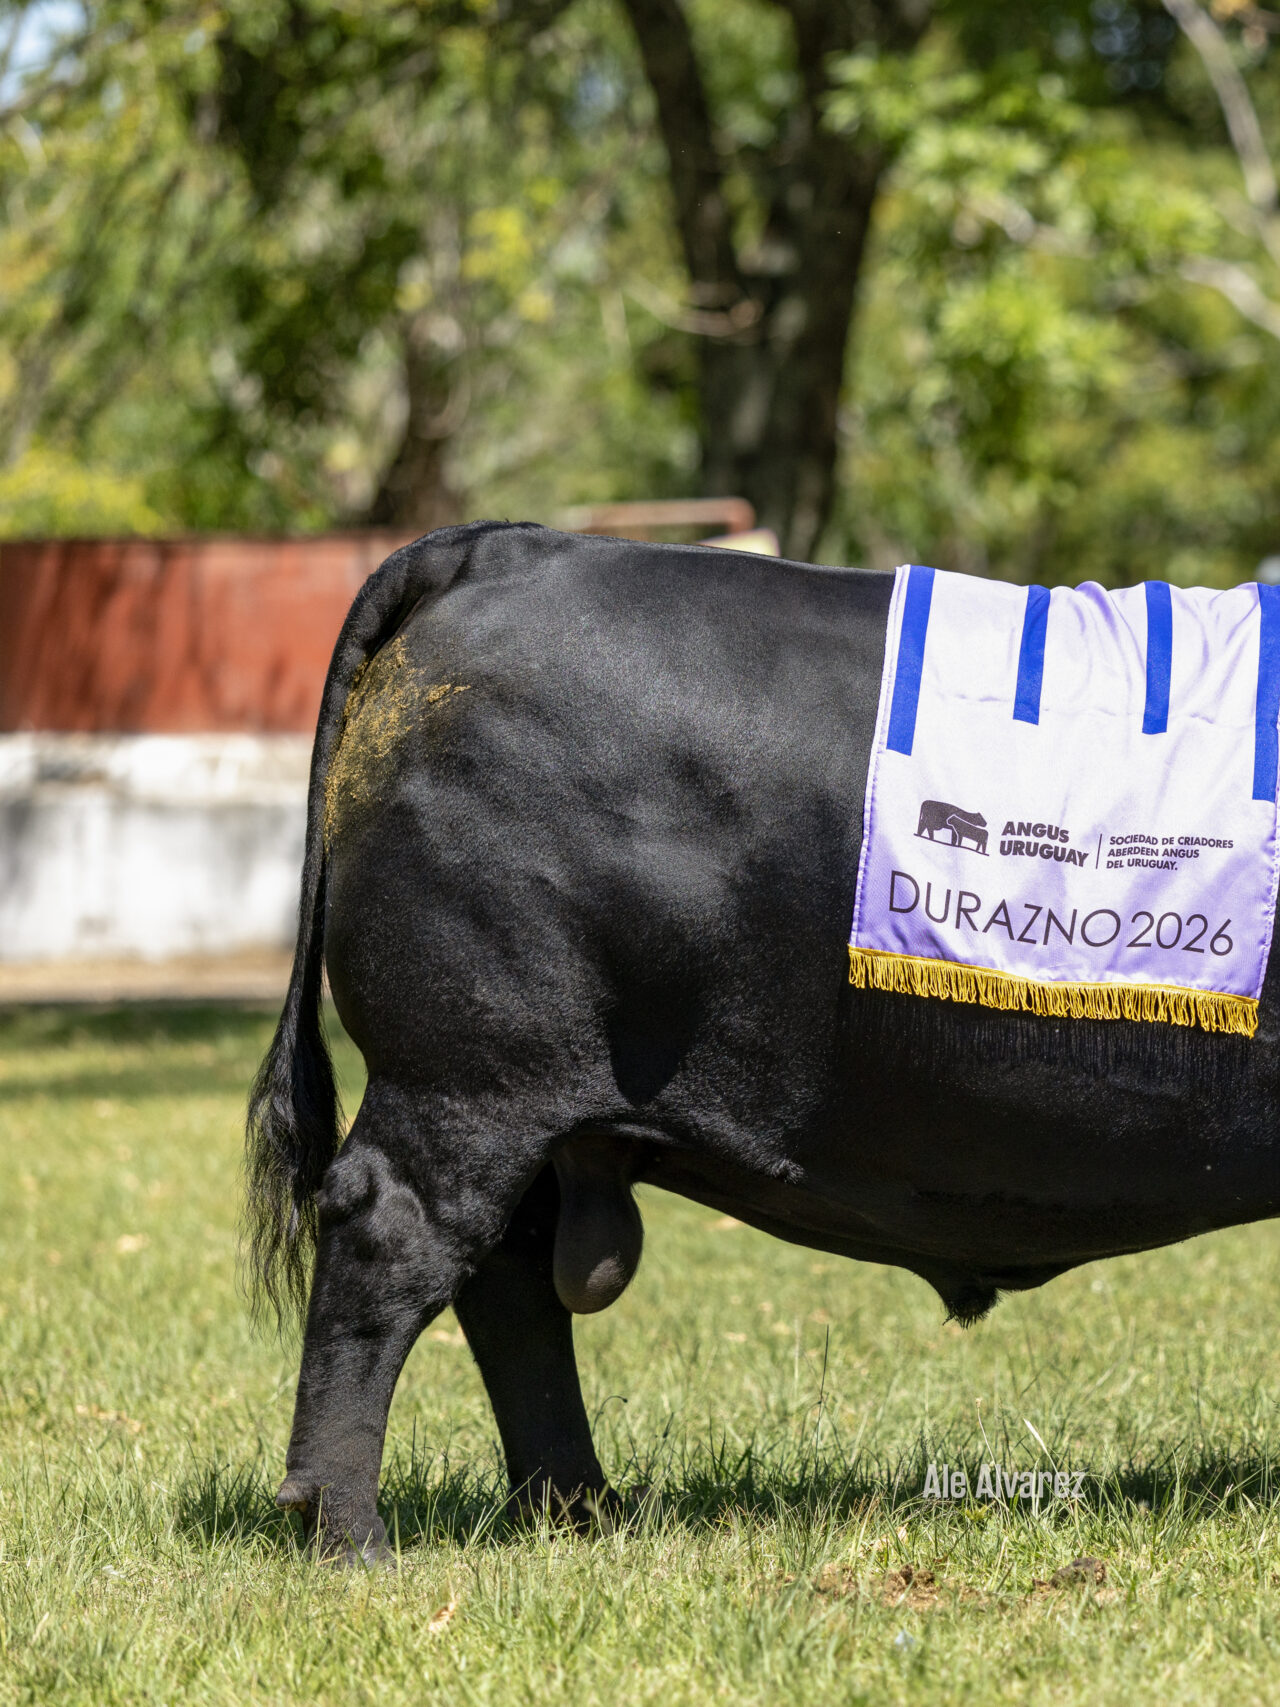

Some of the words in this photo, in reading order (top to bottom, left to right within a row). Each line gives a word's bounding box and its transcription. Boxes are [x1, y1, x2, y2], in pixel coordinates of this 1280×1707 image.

[1001, 821, 1069, 843] ANGUS
[1109, 834, 1158, 846] SOCIEDAD
[1161, 837, 1175, 846] DE
[1177, 836, 1234, 849] CRIADORES
[1000, 840, 1089, 867] URUGUAY
[1108, 846, 1159, 857] ABERDEEN
[1162, 848, 1200, 859] ANGUS
[1106, 860, 1124, 869] DEL
[1127, 858, 1178, 871] URUGUAY.
[888, 870, 1121, 948] DURAZNO
[1127, 910, 1234, 956] 2026
